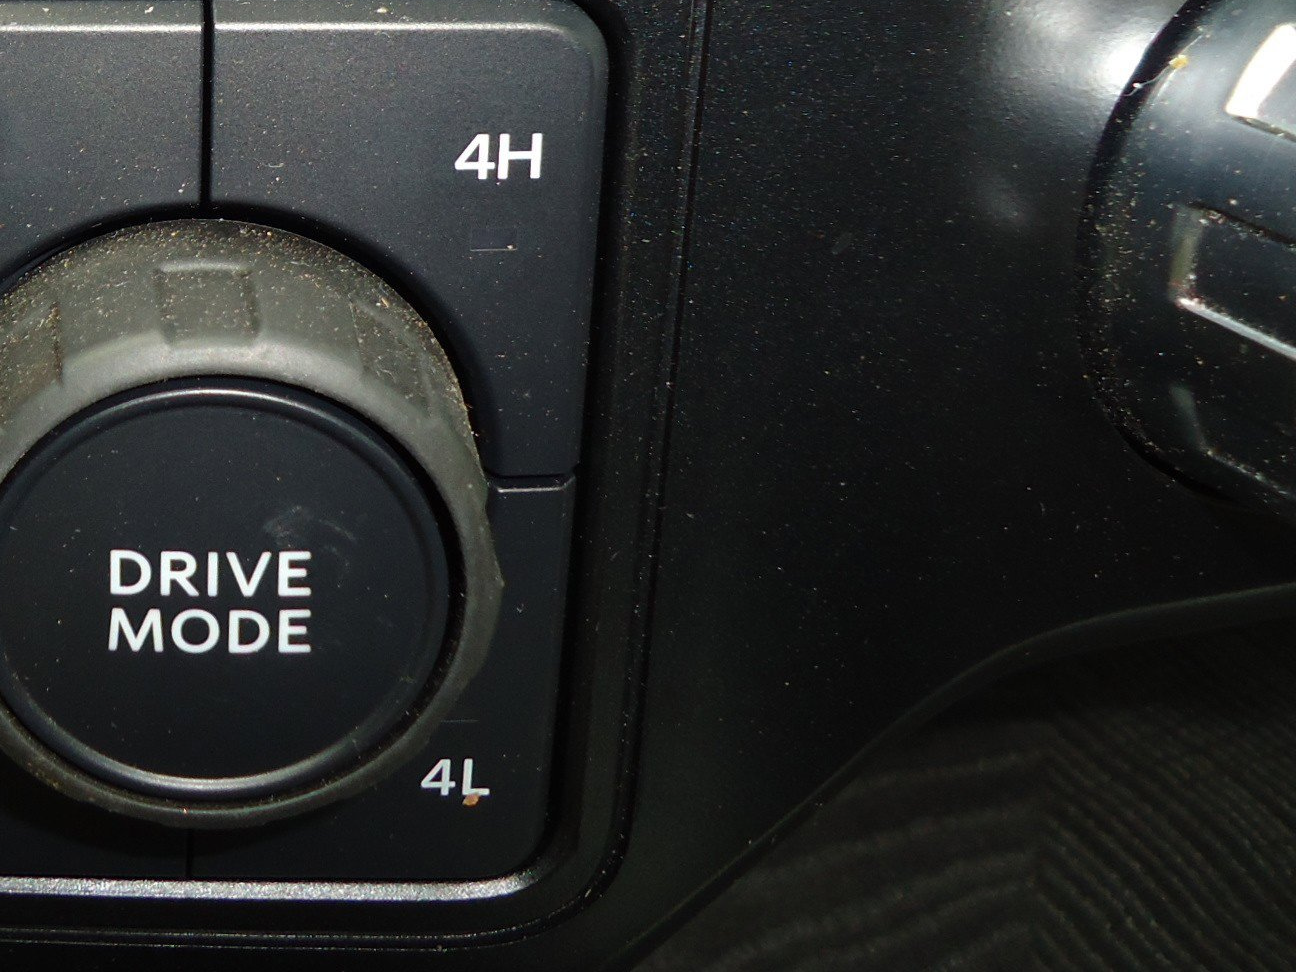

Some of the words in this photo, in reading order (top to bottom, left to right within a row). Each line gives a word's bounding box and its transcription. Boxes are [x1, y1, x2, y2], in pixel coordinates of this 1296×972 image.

[453, 132, 545, 181] 4H
[108, 549, 313, 597] DRIVE
[107, 607, 313, 654] MODE
[419, 757, 491, 798] 4L
